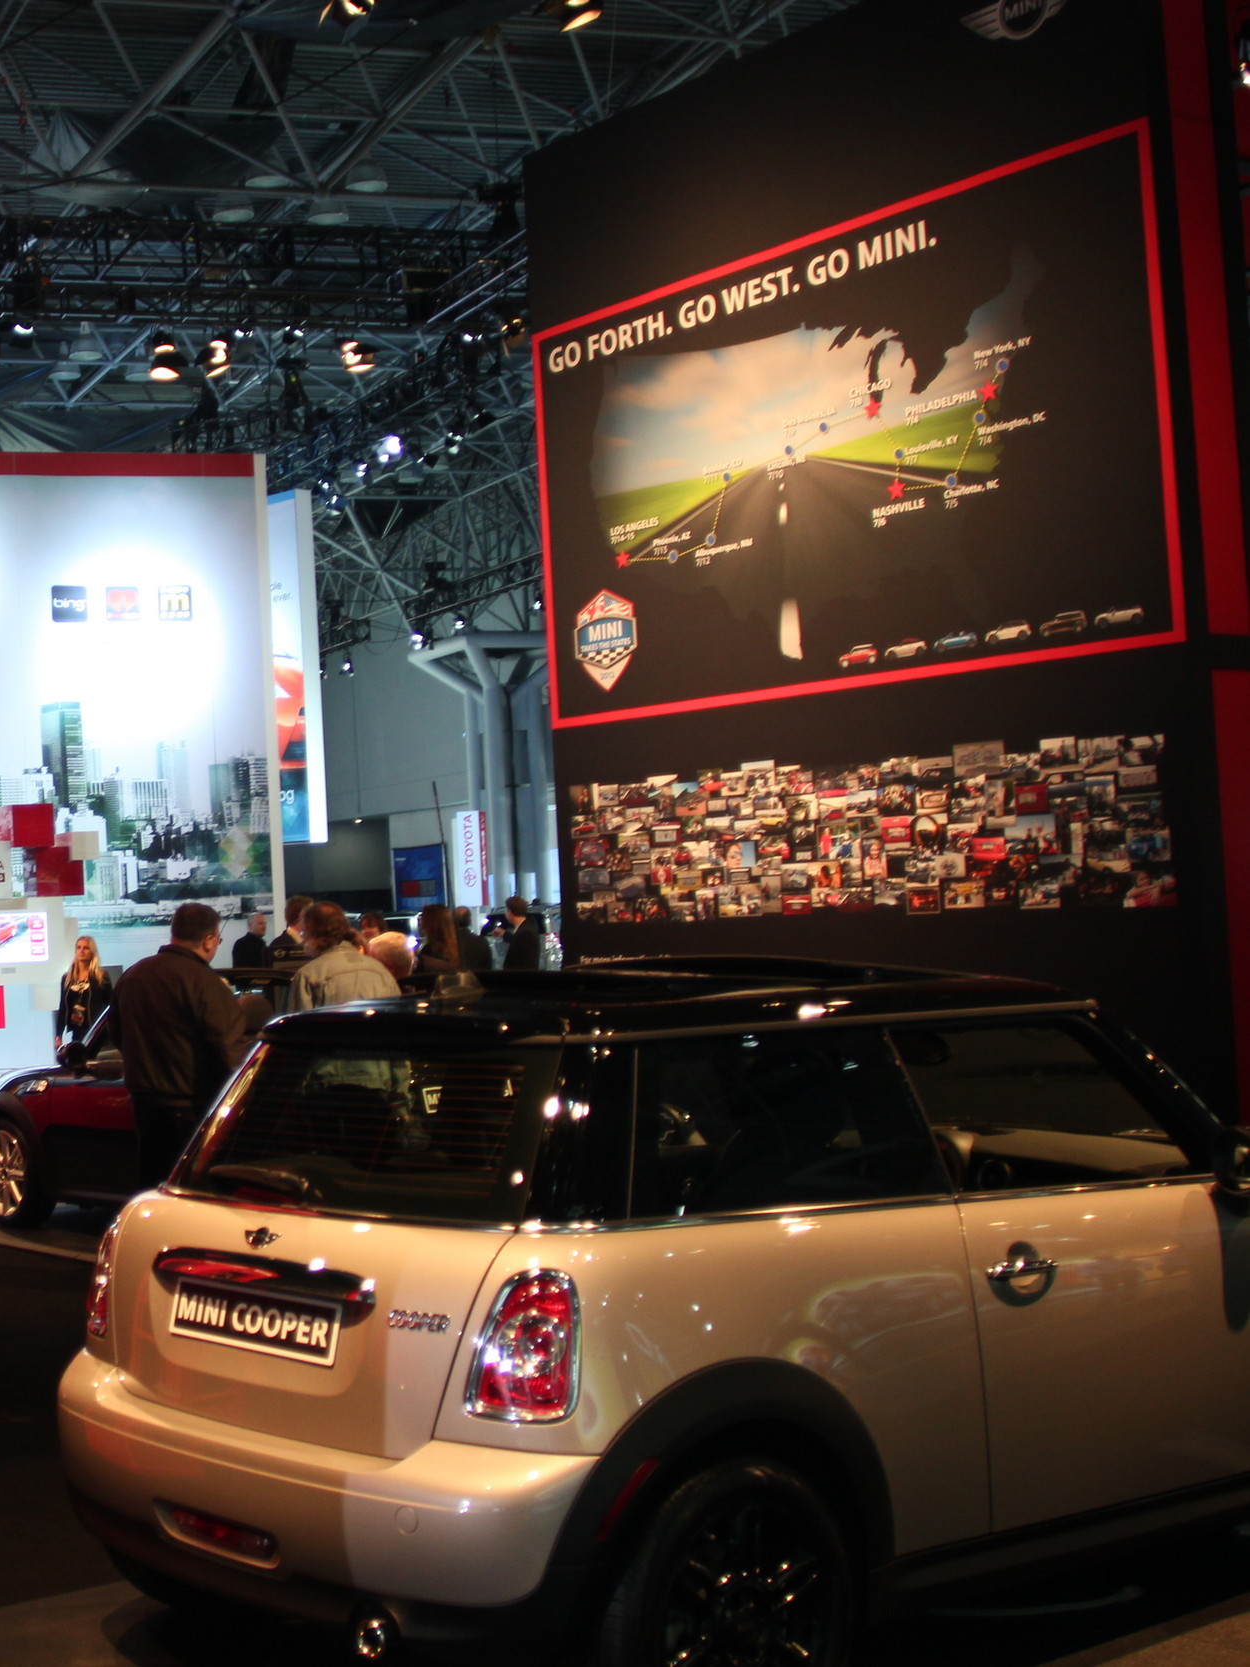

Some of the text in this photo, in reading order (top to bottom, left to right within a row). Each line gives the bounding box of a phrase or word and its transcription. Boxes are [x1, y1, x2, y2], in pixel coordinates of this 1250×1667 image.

[549, 219, 938, 373] GO FORTH. GO WEST. GO MINI.
[974, 349, 991, 360] New
[1018, 336, 1032, 347] NY
[849, 378, 891, 398] CHICAGO
[905, 389, 978, 417] PHILADELPHIA
[1033, 411, 1046, 423] DC
[946, 434, 959, 445] KY
[986, 478, 1000, 490] NC
[872, 497, 926, 518] NASHVILLE
[610, 516, 659, 536] LOS ANGELES
[53, 597, 87, 612] bing
[588, 620, 623, 643] MINI
[463, 814, 474, 865] TOYOTA
[177, 1292, 328, 1348] MINI COOPER
[387, 1309, 449, 1332] COOPER
